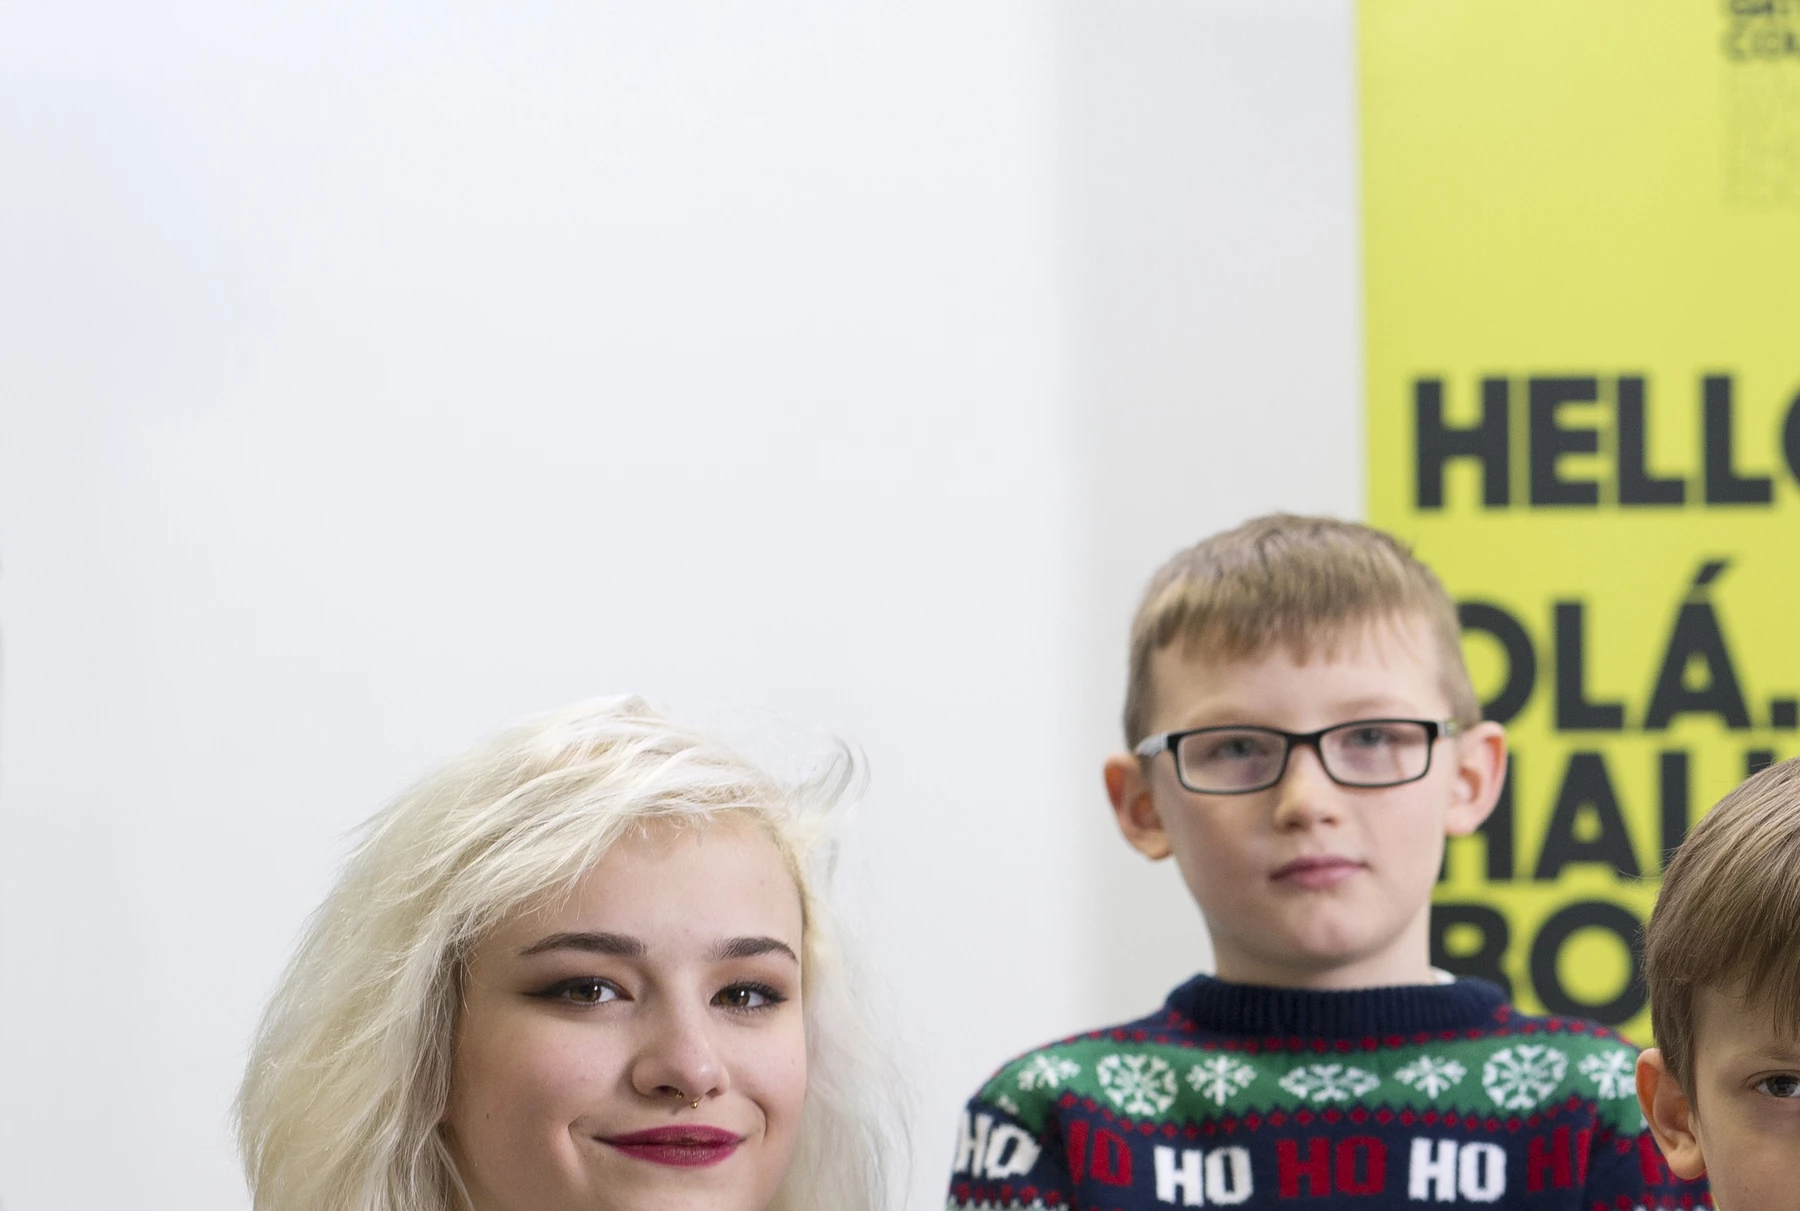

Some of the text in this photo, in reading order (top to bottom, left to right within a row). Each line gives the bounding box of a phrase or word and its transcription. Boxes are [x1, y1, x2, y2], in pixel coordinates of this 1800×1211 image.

[1153, 1144, 1254, 1207] HO
[1275, 1135, 1388, 1198] HO
[1407, 1137, 1507, 1202] HO
